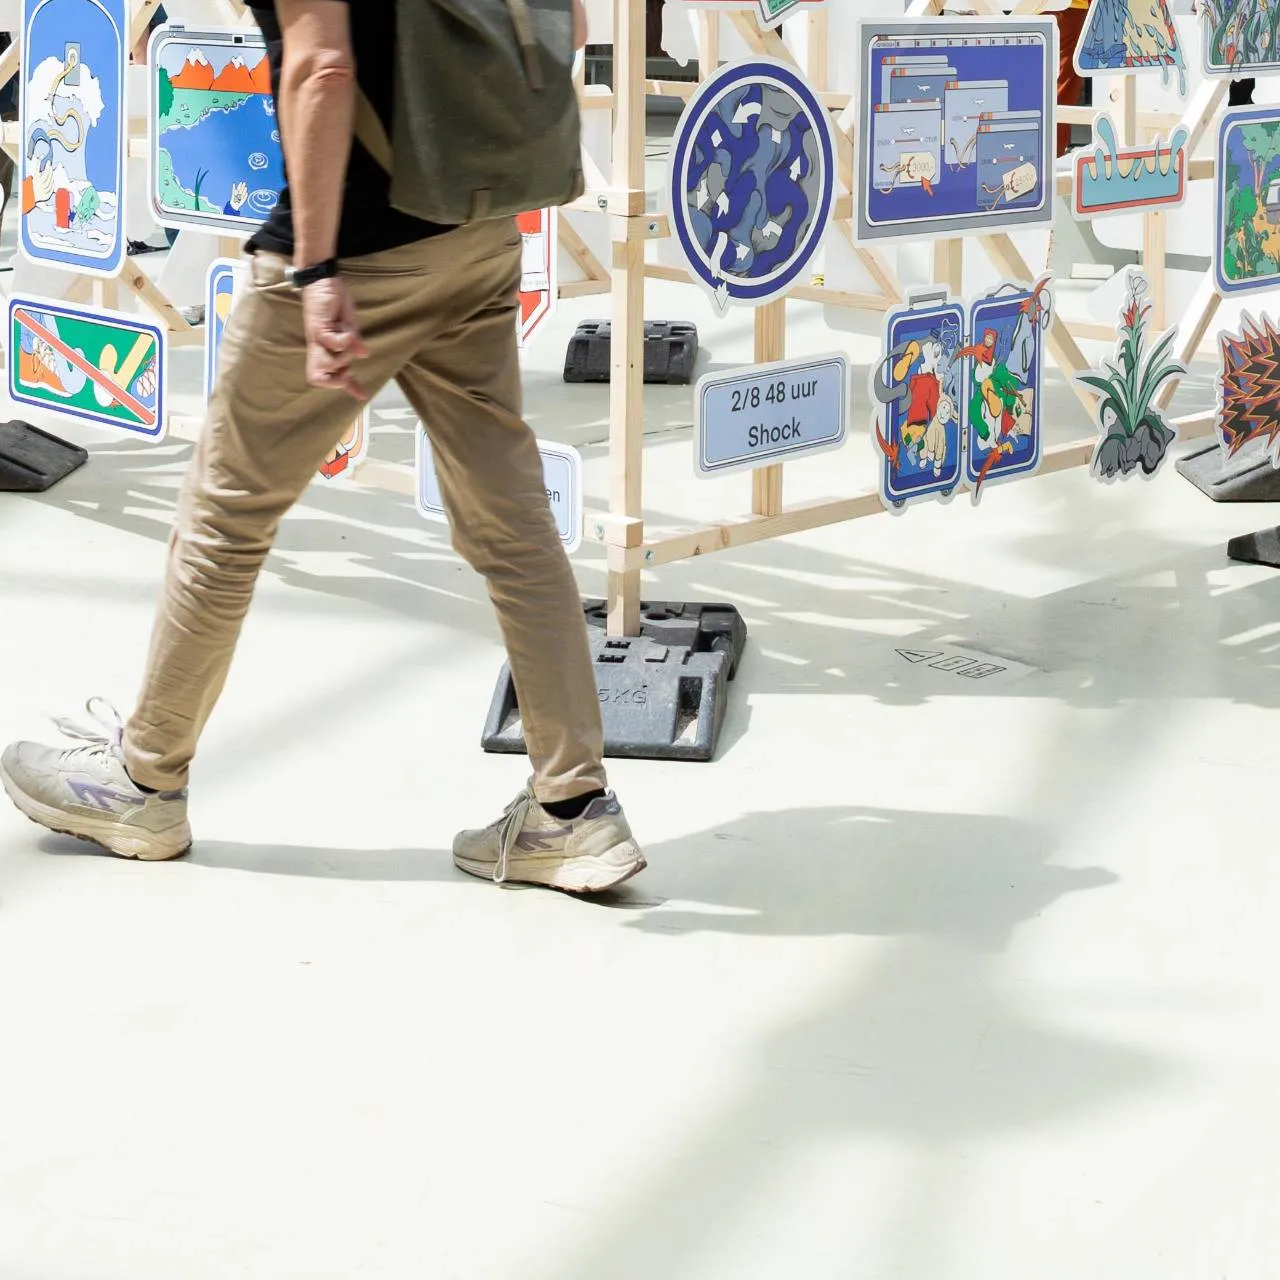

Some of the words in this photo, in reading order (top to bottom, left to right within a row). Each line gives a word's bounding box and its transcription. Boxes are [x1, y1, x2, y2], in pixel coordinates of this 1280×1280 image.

[731, 386, 760, 412] 2/8
[765, 381, 786, 404] 48
[791, 379, 818, 400] uur
[748, 416, 801, 448] Shock
